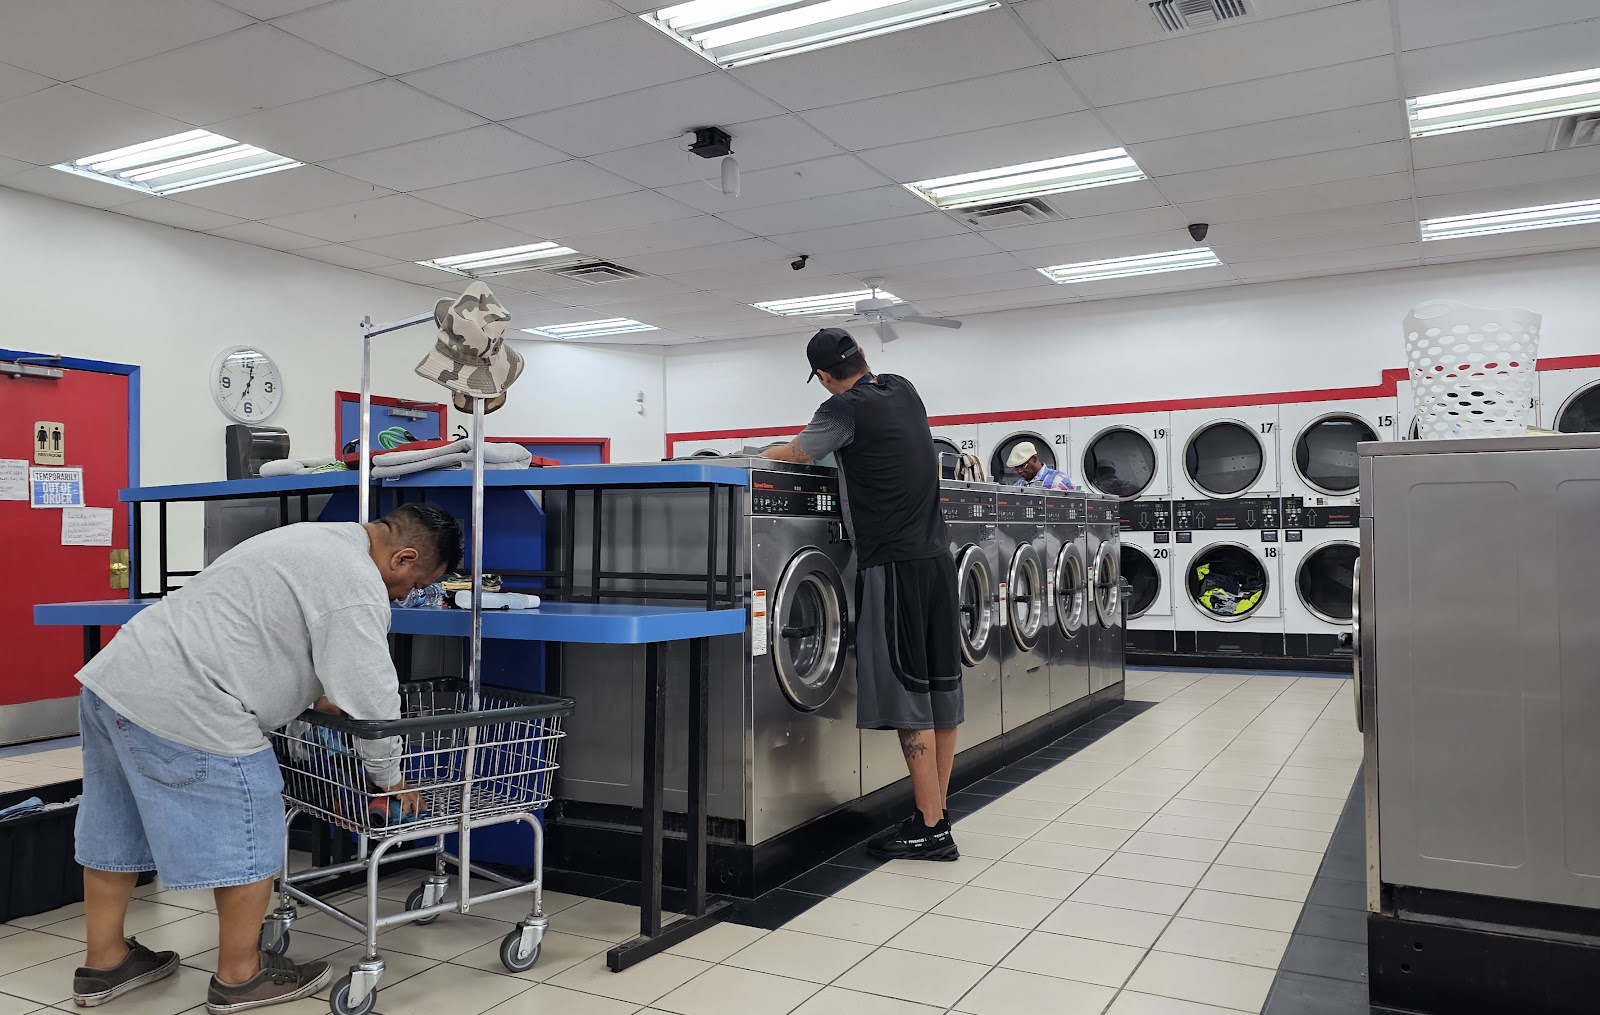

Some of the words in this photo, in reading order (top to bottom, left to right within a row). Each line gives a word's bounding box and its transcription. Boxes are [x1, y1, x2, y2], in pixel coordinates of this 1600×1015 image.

[241, 357, 254, 368] 12
[222, 376, 231, 389] 9
[264, 381, 273, 393] 3
[244, 402, 253, 414] 6
[1377, 415, 1393, 427] 15
[1153, 428, 1165, 439] 19
[1260, 422, 1274, 434] 17
[961, 440, 974, 450] 23
[1055, 434, 1066, 445] 21
[35, 473, 77, 481] TEMPORARILY
[42, 482, 60, 493] OUT
[61, 482, 72, 493] OF
[43, 493, 73, 504] ORDER
[1153, 548, 1168, 559] 20
[1264, 547, 1277, 558] 18
